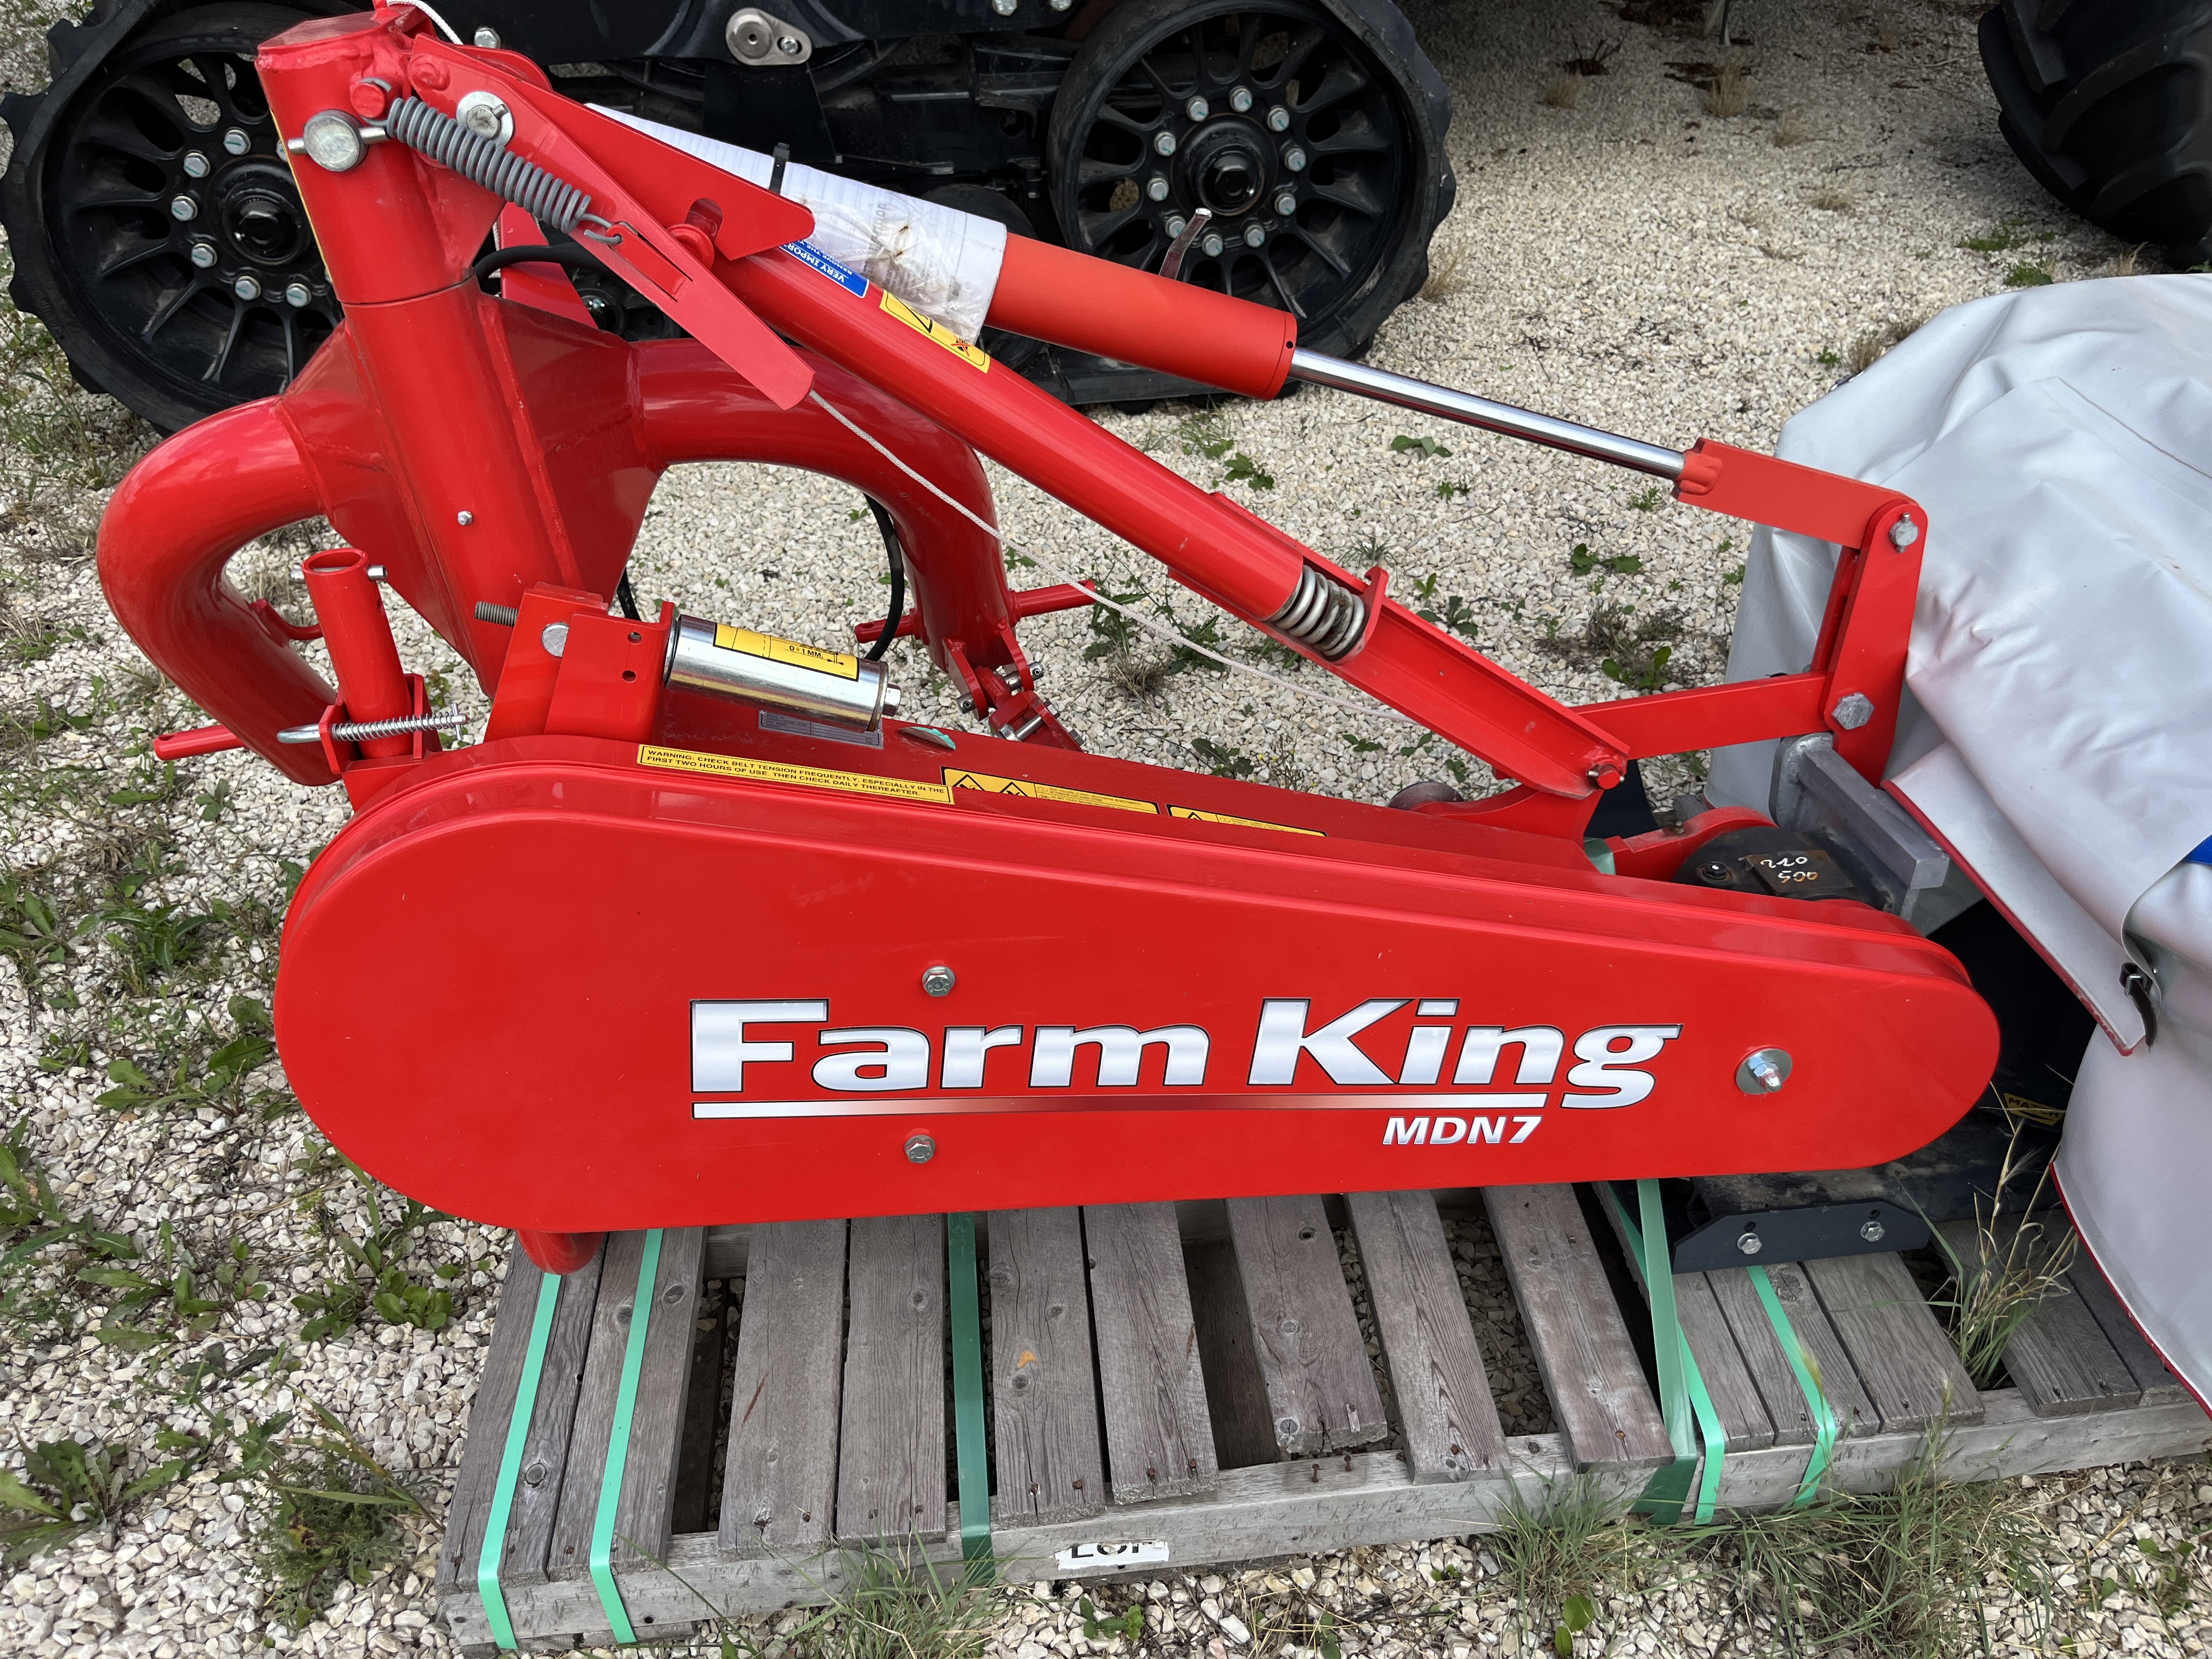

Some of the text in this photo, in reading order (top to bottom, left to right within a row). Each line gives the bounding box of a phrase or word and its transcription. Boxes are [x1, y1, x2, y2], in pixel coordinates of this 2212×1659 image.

[784, 242, 820, 267] IMPOR
[806, 244, 821, 256] THE
[820, 264, 845, 283] VERY
[822, 254, 853, 275] REMOVE
[648, 750, 695, 760] WARNING:
[697, 757, 729, 765] CHECK
[758, 764, 797, 774] TENSION
[799, 770, 860, 783] FREQUENTLY,
[863, 778, 915, 789] ESPECIALLY
[699, 763, 732, 771] HOURS
[861, 784, 921, 795] THEREAFTER.
[1760, 856, 1808, 869] 220
[1777, 870, 1819, 883] 500
[690, 997, 1684, 1109] Farm King
[1382, 1115, 1542, 1145] MDN7
